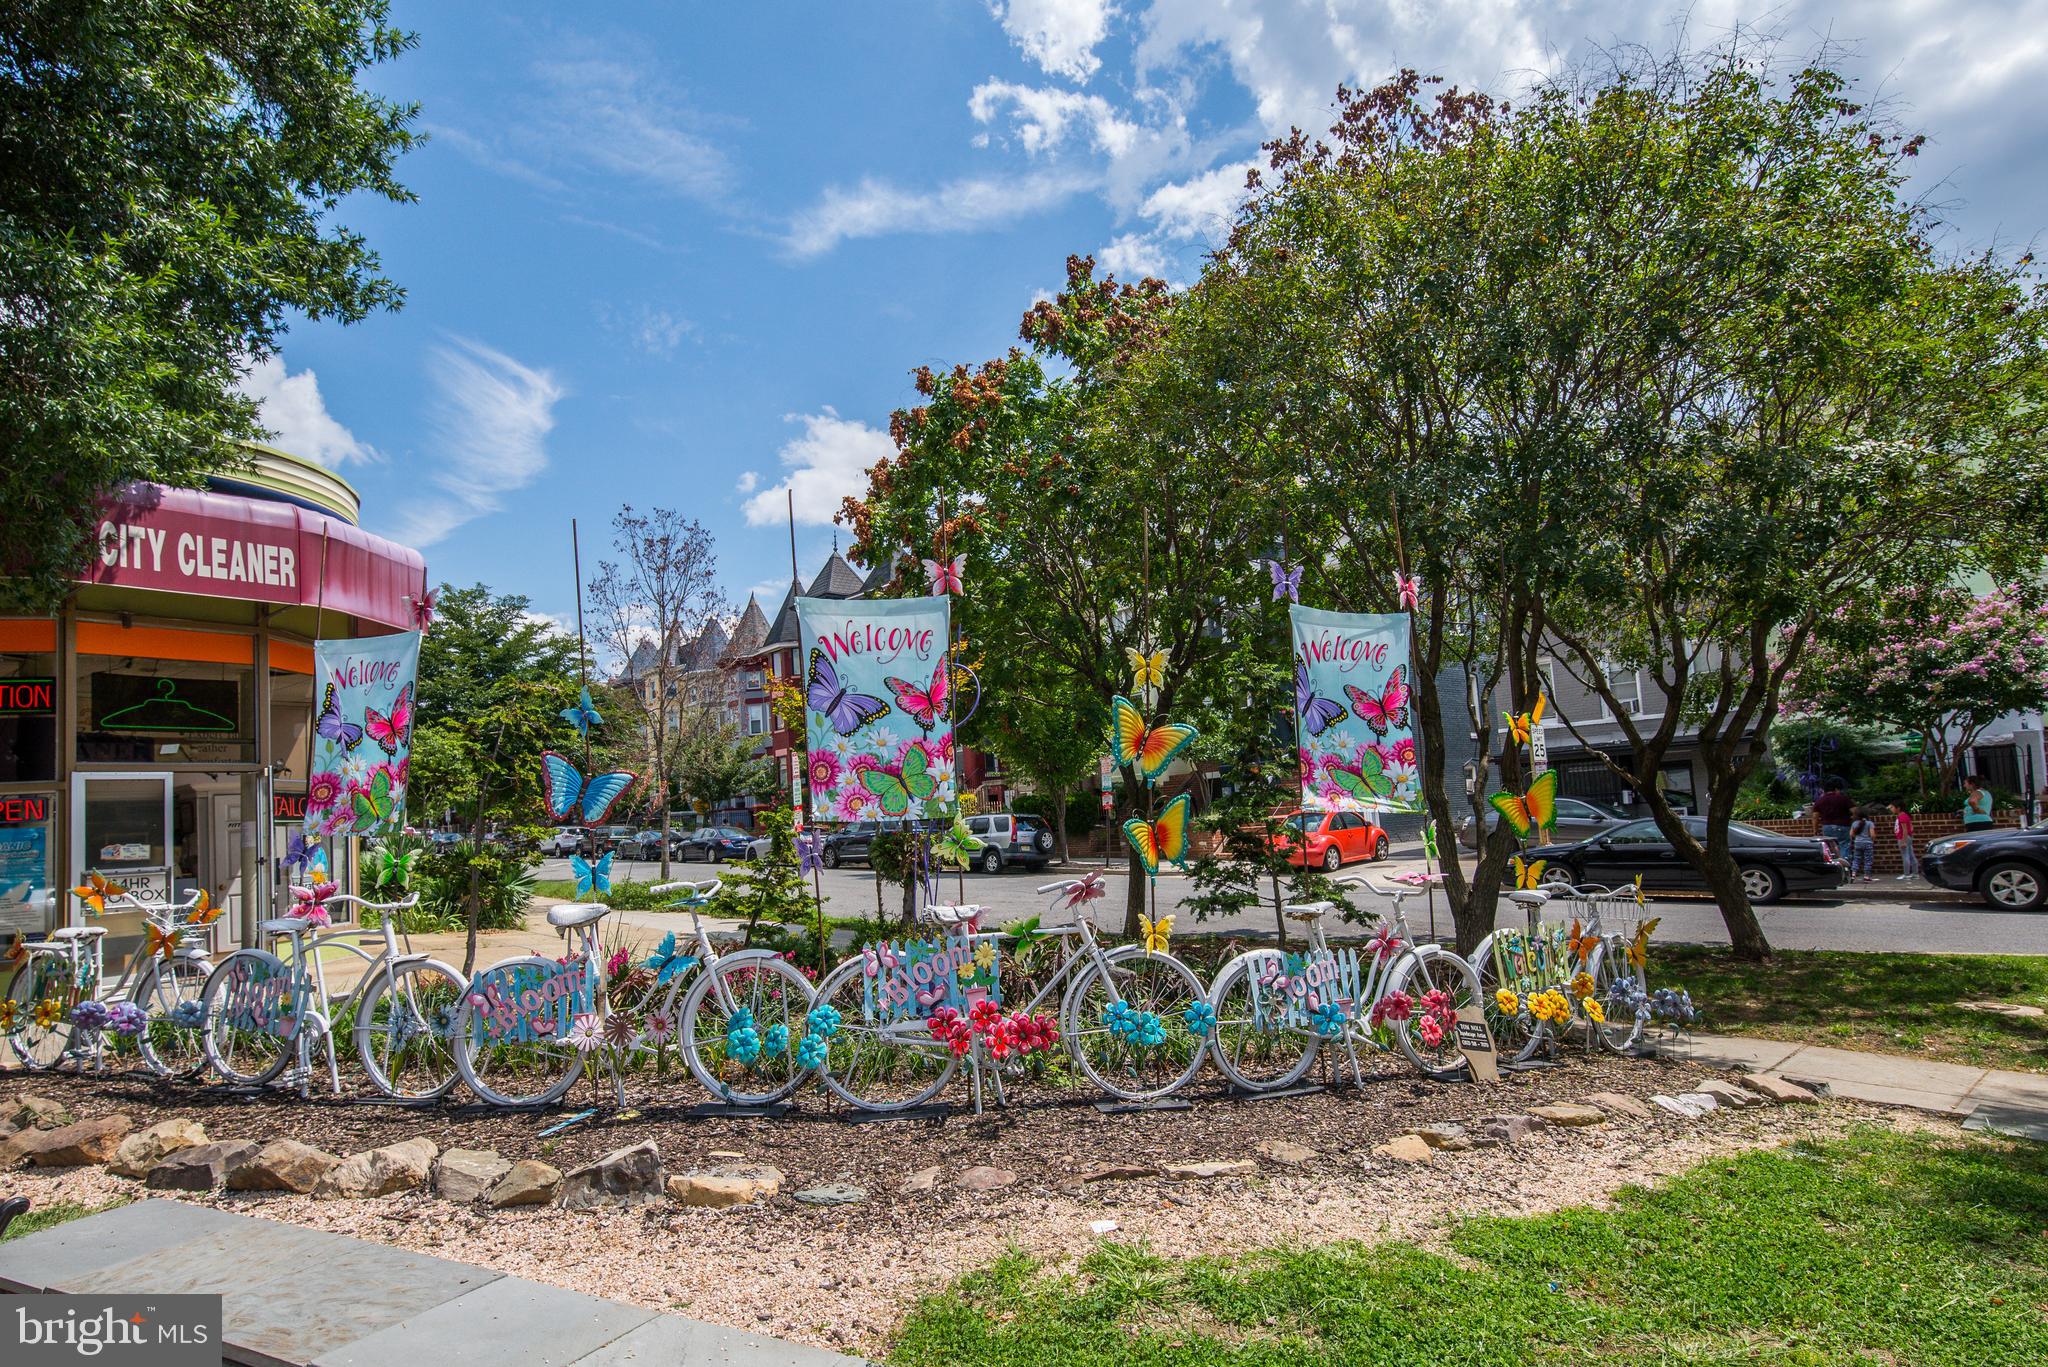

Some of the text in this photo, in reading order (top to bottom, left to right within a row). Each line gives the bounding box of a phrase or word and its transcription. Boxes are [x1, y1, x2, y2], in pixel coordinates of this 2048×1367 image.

[98, 520, 296, 588] CITY CLEANER
[818, 620, 934, 664] Welcome
[1301, 630, 1388, 672] Welcome
[330, 656, 401, 696] Welcome
[1534, 744, 1546, 757] 25
[882, 945, 972, 1007] Bloom
[491, 971, 581, 1033] Bloom
